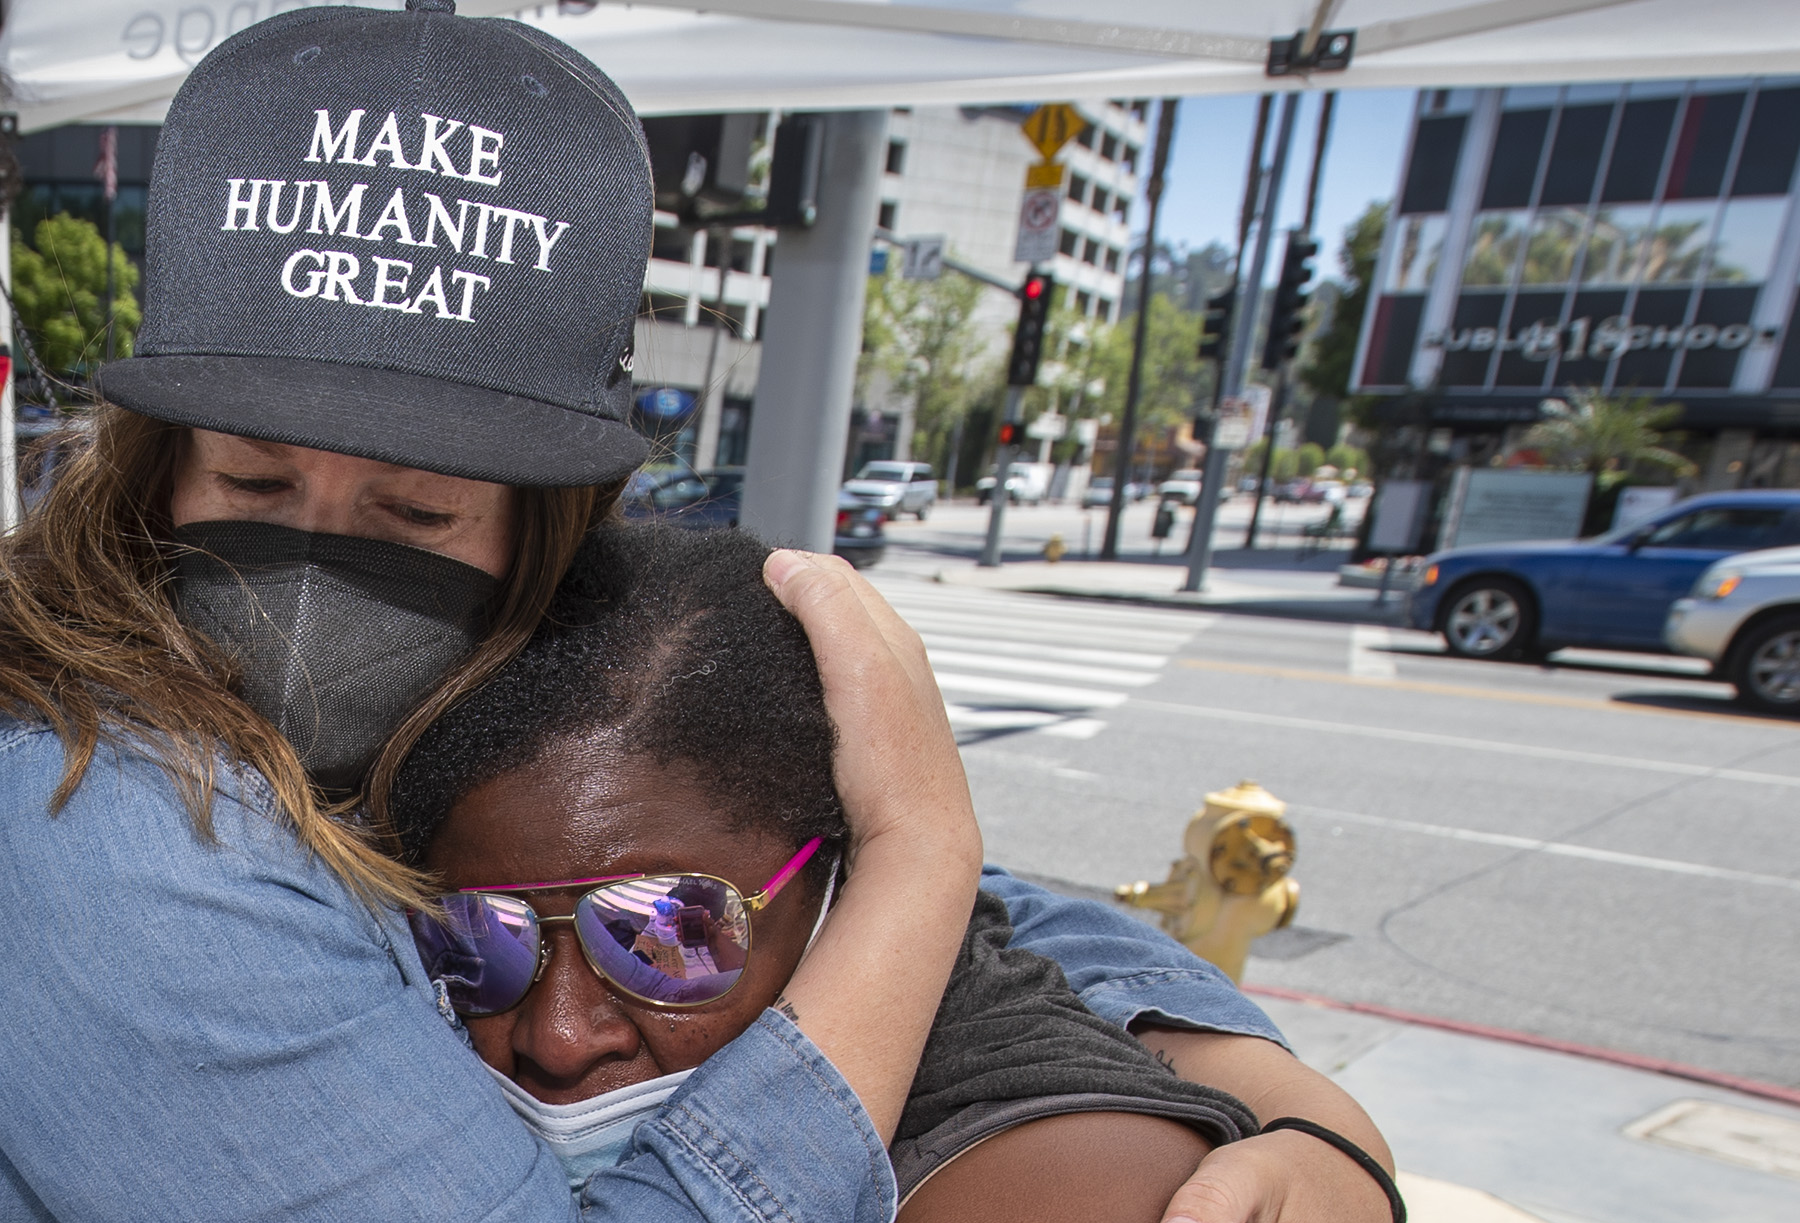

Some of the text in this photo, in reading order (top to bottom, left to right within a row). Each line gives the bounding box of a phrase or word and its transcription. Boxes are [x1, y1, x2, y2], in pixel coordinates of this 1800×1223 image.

[304, 109, 504, 187] MAKE
[221, 179, 570, 272] HUMANITY
[281, 249, 490, 323] GREAT
